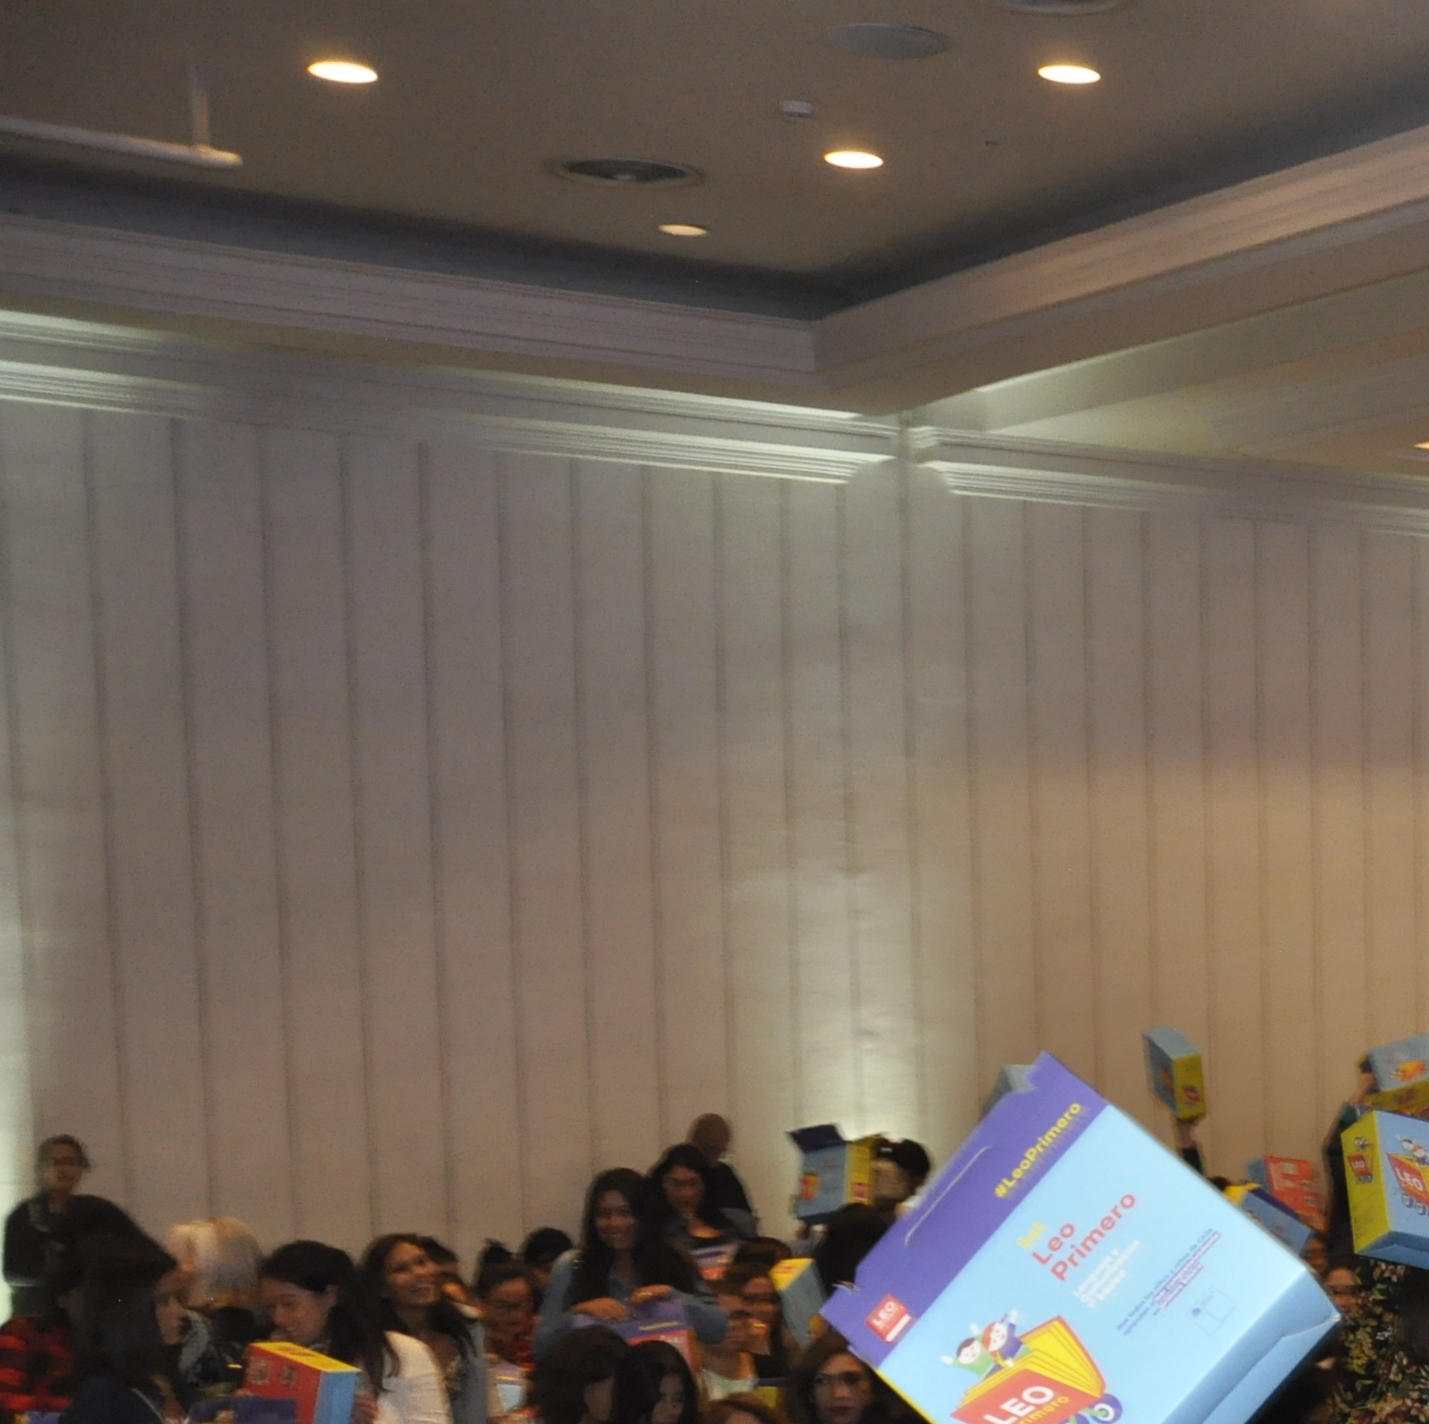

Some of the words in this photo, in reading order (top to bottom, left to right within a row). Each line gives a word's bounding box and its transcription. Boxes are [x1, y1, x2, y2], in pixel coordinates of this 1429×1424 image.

[994, 1102, 1082, 1198] #LeoPrimero
[1397, 1168, 1423, 1192] LEO
[1032, 1222, 1076, 1265] Leo
[1050, 1193, 1136, 1282] Primero
[872, 1301, 896, 1327] LEO
